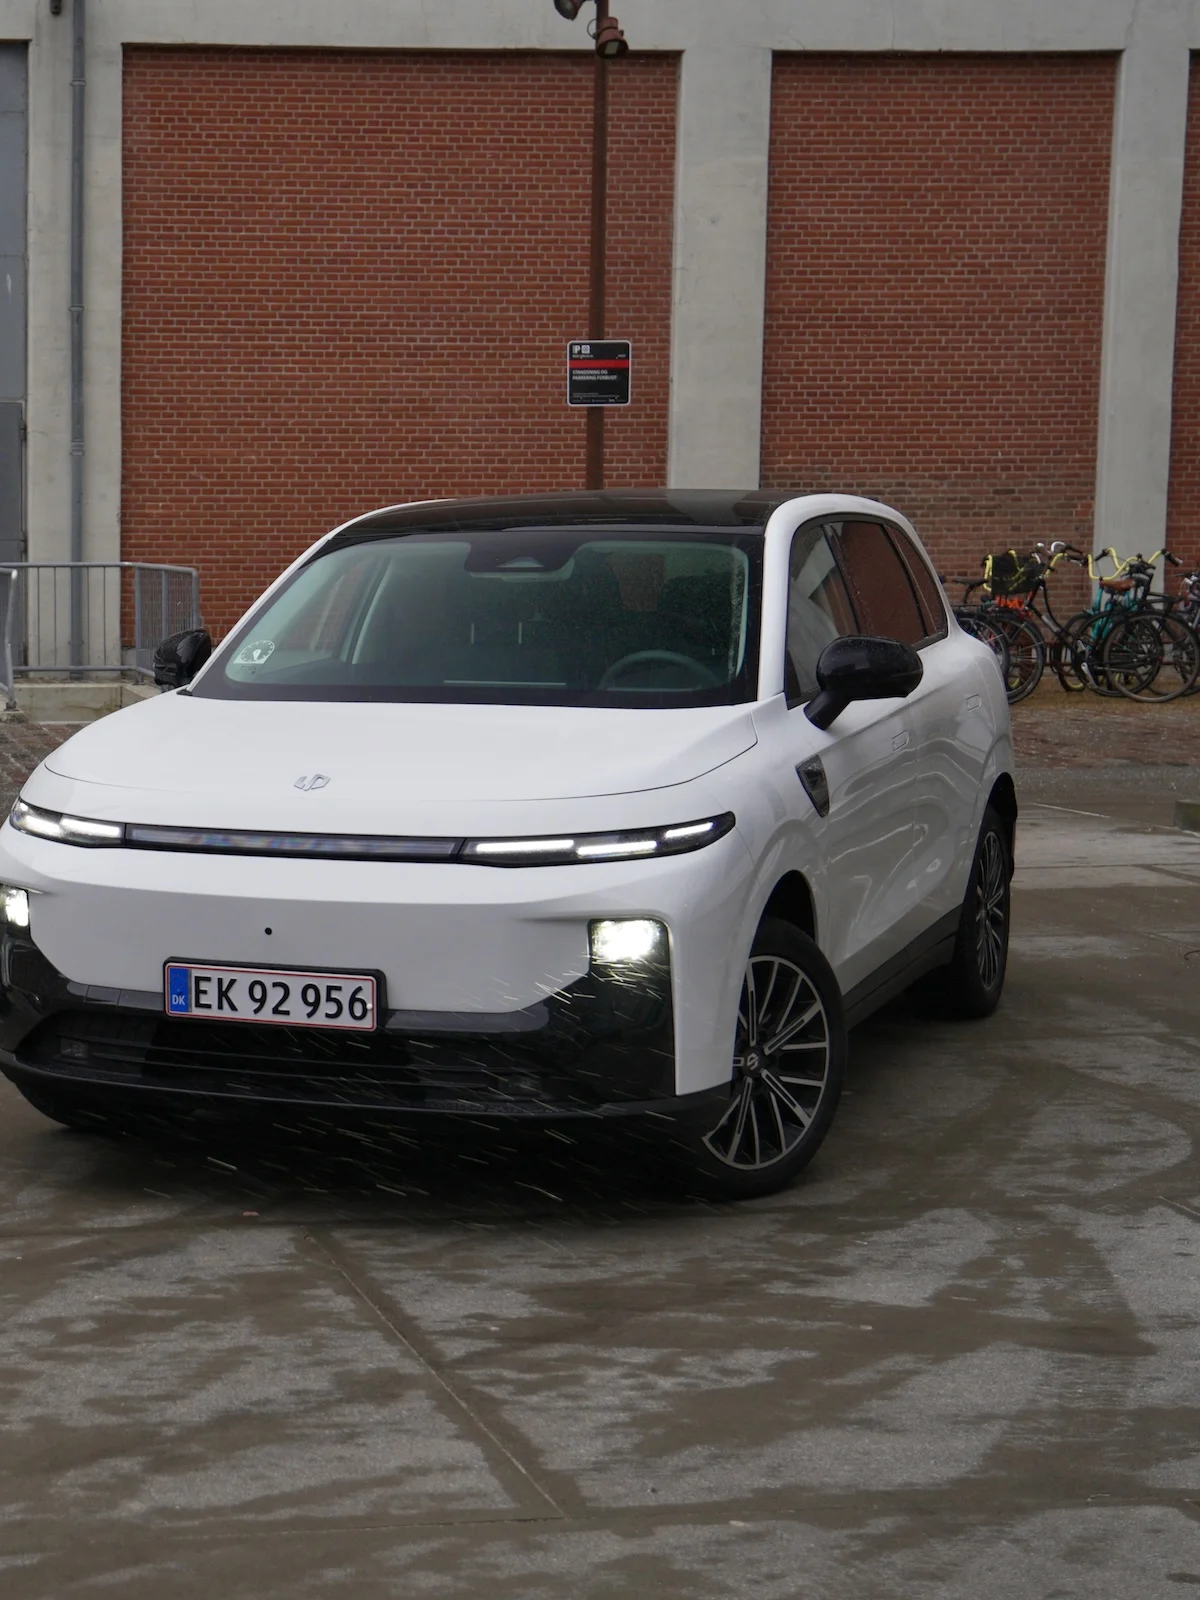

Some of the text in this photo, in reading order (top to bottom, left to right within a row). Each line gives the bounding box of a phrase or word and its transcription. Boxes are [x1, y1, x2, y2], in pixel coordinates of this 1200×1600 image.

[172, 994, 185, 1006] DK
[194, 976, 368, 1020] EK 92 956
